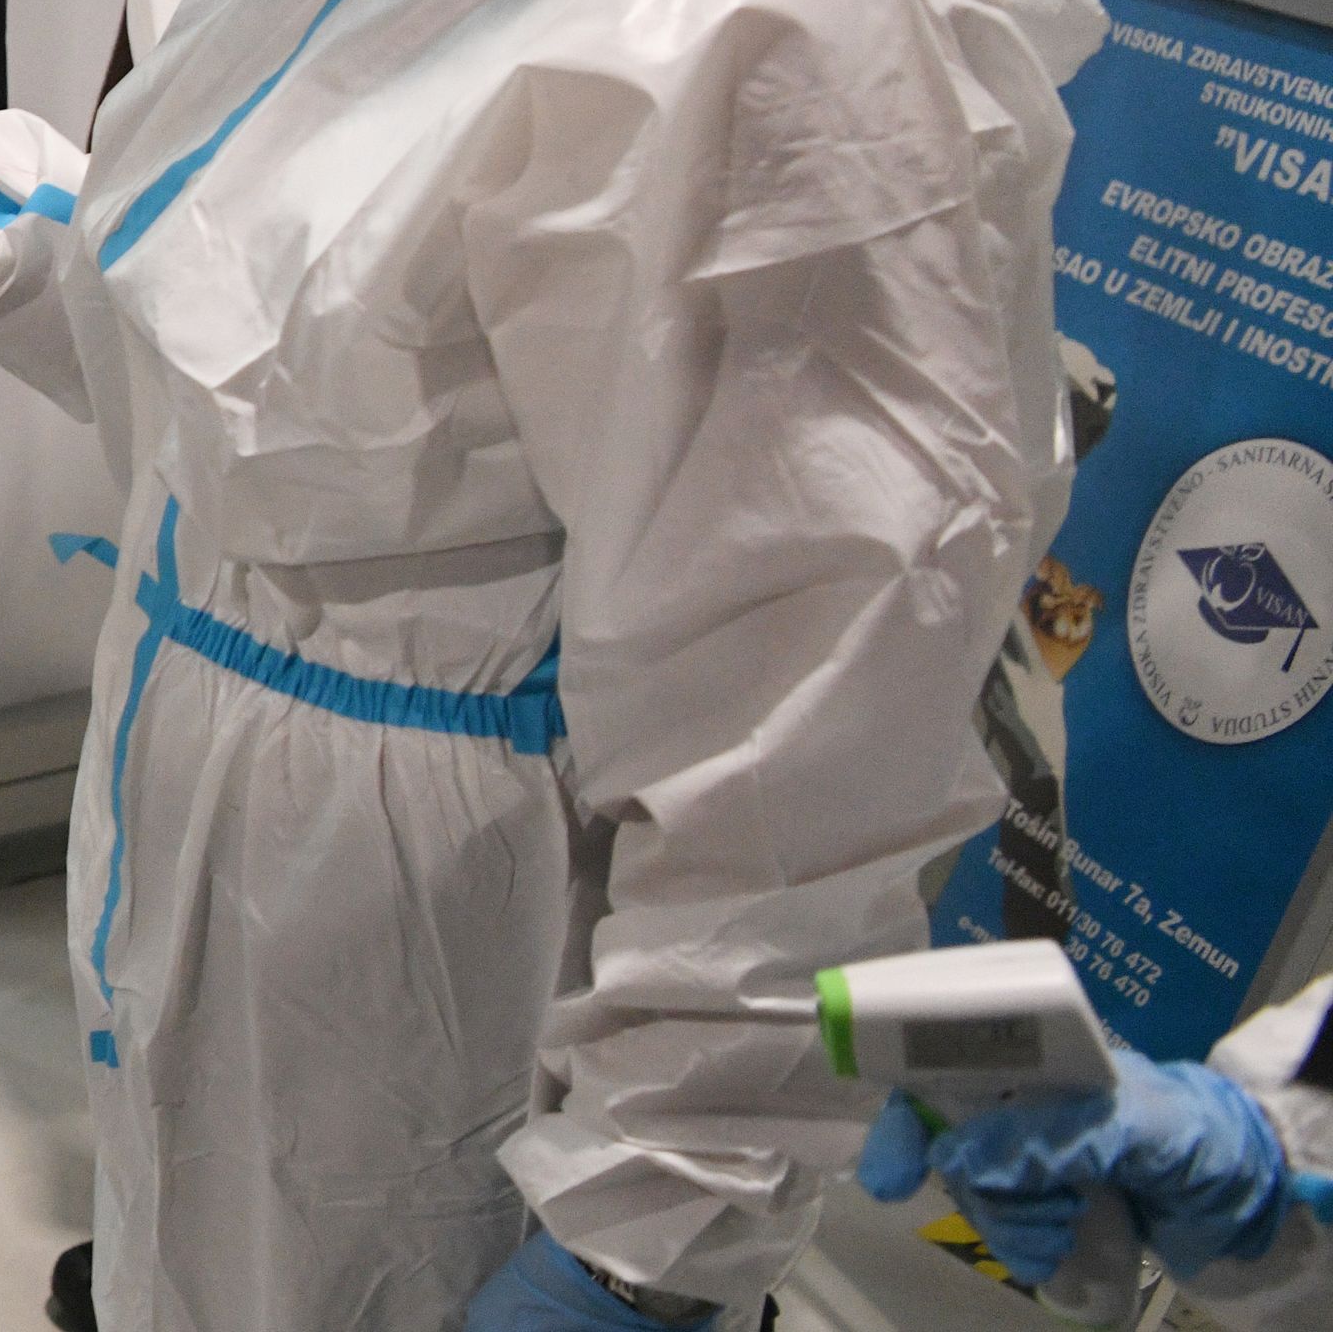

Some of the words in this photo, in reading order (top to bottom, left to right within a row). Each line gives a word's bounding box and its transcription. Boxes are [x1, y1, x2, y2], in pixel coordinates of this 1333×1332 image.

[1112, 21, 1184, 62] VISOKA
[1101, 179, 1242, 250] EVROPSKO
[1129, 235, 1216, 287] ELITNI
[1104, 268, 1129, 295] U
[1126, 278, 1223, 336] ZEMLJI
[1222, 319, 1239, 344] I
[1253, 584, 1308, 626] VISAN
[1063, 838, 1123, 893] Bunar
[1124, 883, 1153, 925] 7a,
[1158, 909, 1239, 979] Zemun
[1089, 954, 1113, 981] 76
[1114, 974, 1150, 1007] 470
[1100, 932, 1125, 956] 76
[1125, 950, 1163, 985] 472
